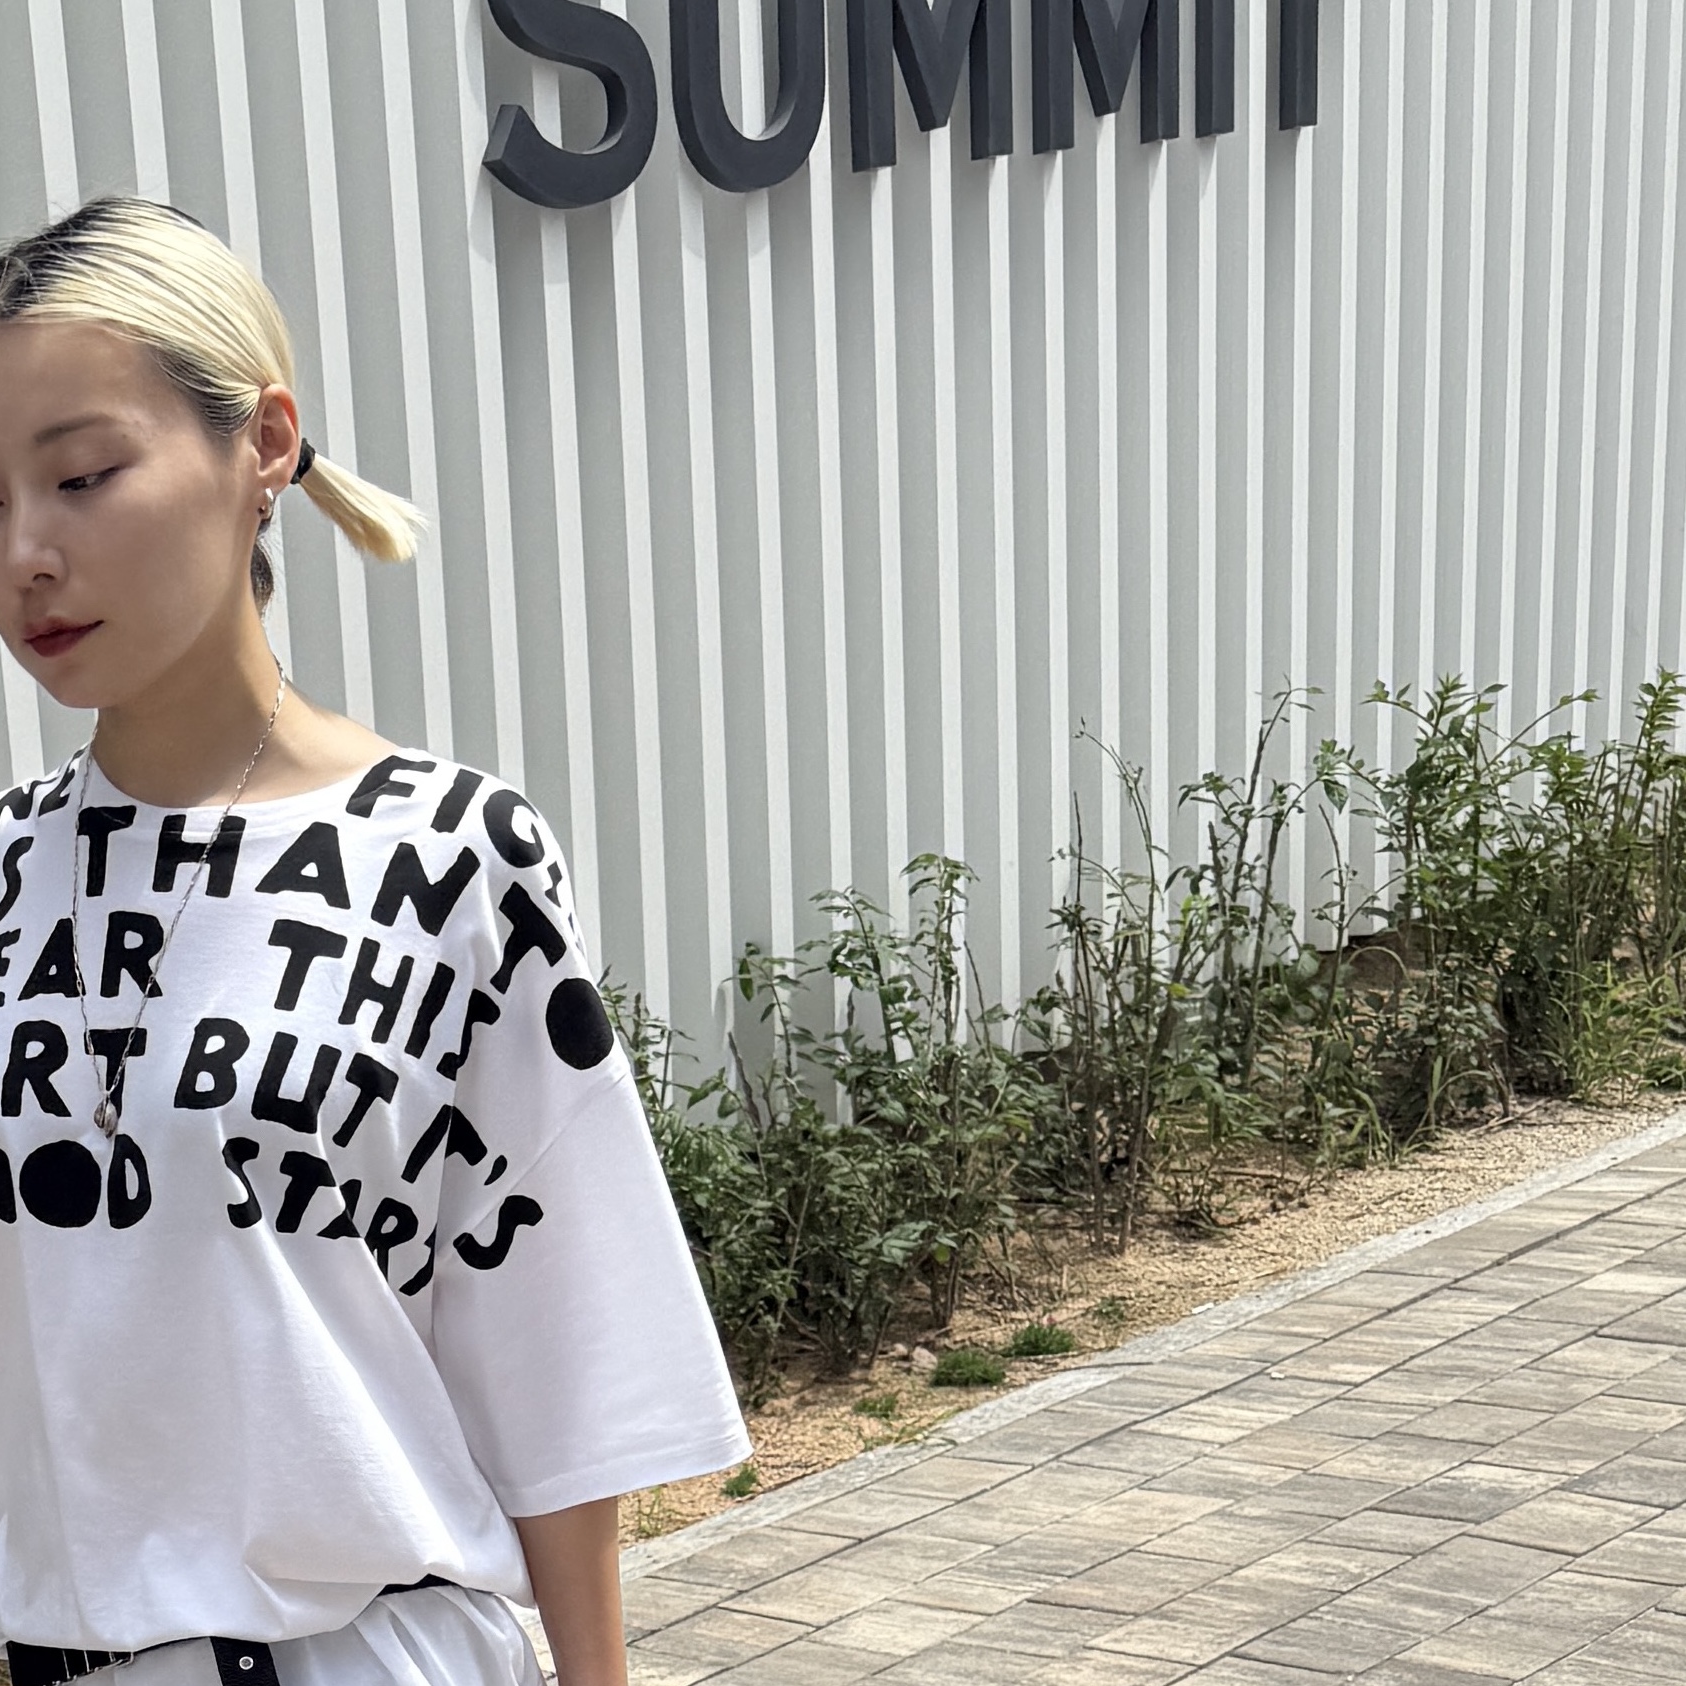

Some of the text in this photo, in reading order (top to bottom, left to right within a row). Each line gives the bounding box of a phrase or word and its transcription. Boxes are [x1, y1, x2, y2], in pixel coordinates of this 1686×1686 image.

[77, 806, 481, 936] THAN
[268, 919, 501, 1082] THIS
[174, 1017, 400, 1147] BUT
